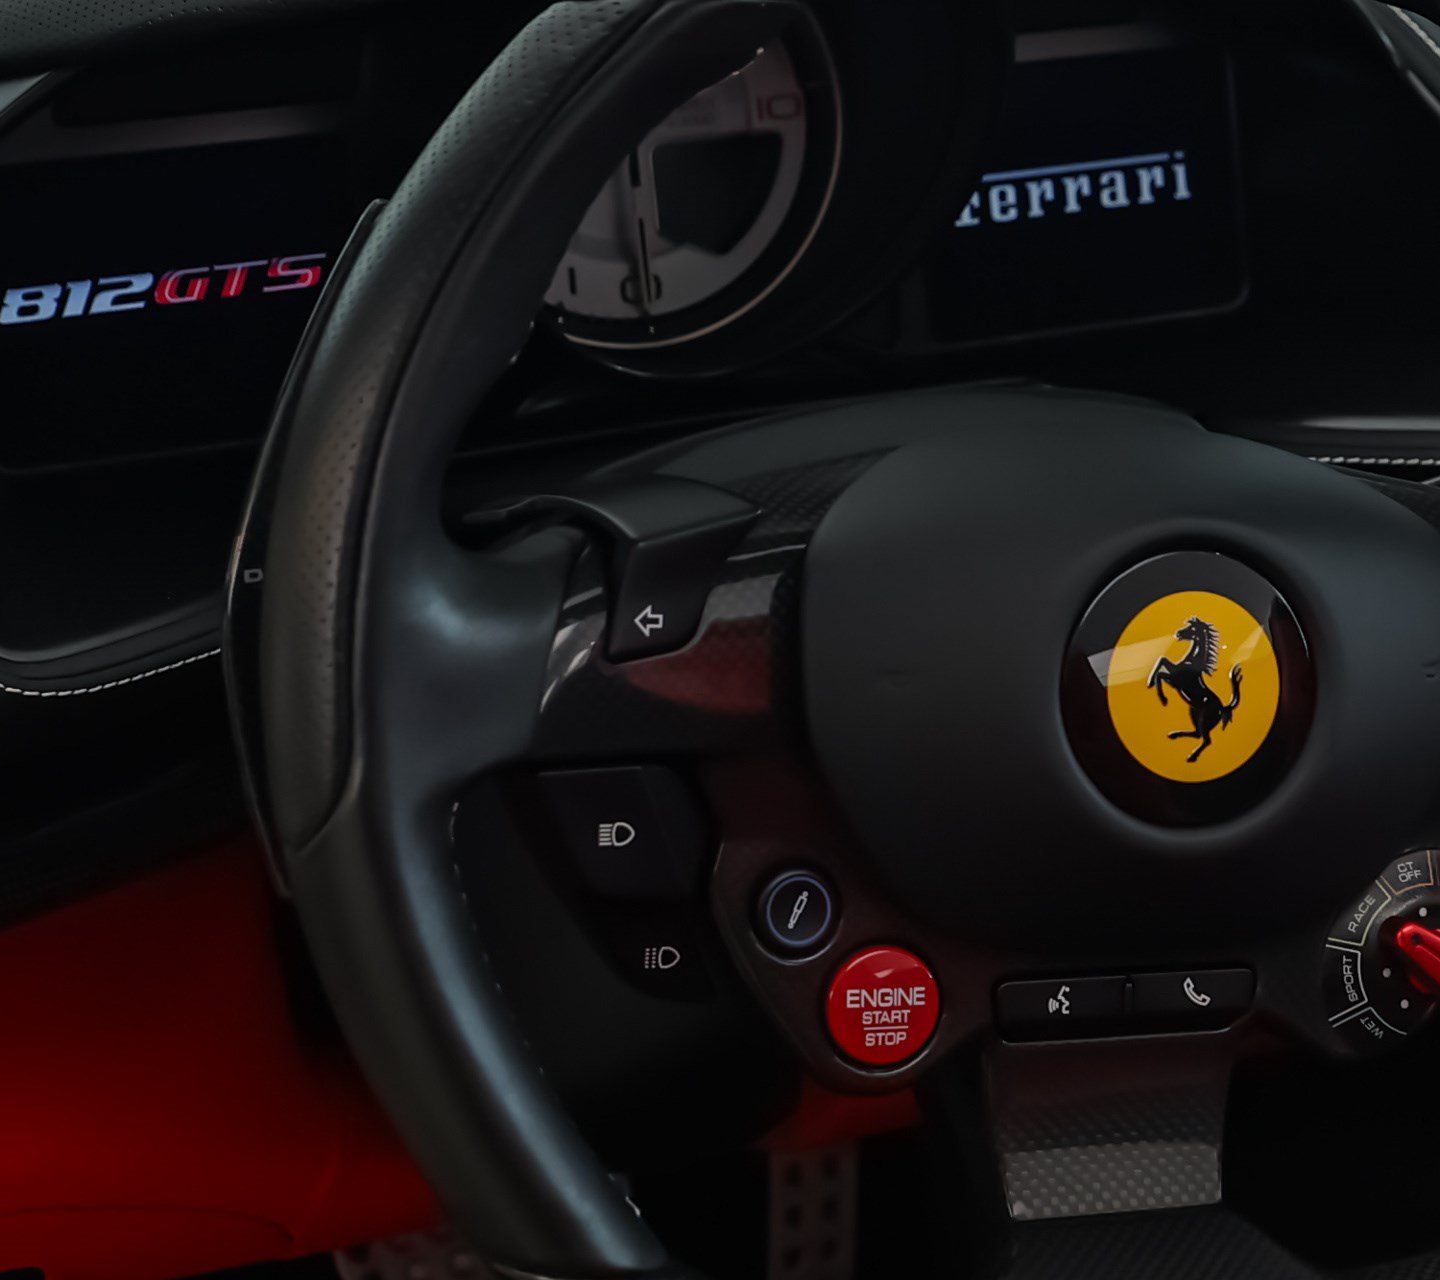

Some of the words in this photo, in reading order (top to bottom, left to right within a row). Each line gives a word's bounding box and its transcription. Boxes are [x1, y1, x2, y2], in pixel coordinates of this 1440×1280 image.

[1397, 861, 1414, 874] CT
[1398, 869, 1423, 883] OFF
[1347, 895, 1377, 933] RACE
[1342, 954, 1360, 1003] SPORT
[846, 986, 926, 1009] ENGINE
[861, 1009, 912, 1026] START
[1360, 1016, 1385, 1040] WET
[864, 1031, 908, 1048] STOP
